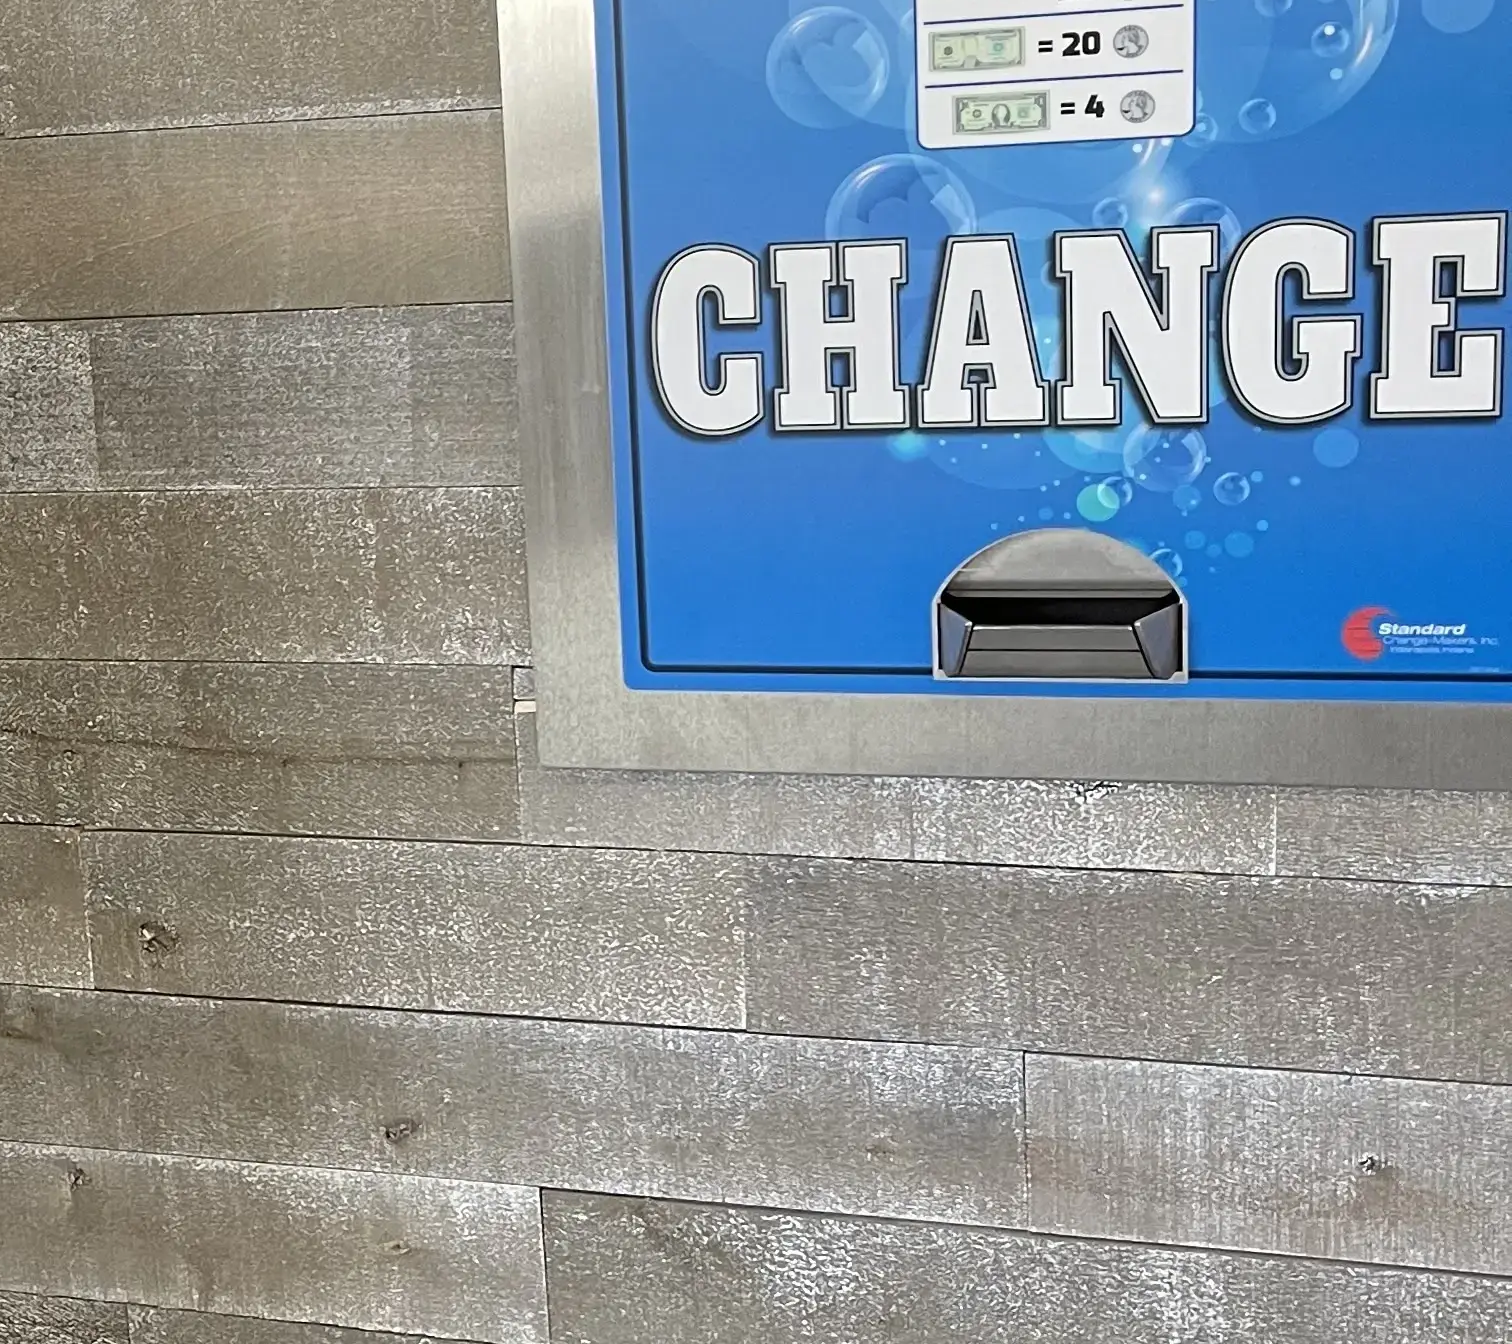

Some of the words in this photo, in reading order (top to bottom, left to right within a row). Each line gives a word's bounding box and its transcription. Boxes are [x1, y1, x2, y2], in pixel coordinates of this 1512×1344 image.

[1062, 31, 1101, 56] 20
[1084, 94, 1105, 118] 4
[652, 211, 1508, 436] CHANGE
[1379, 623, 1466, 635] Standard
